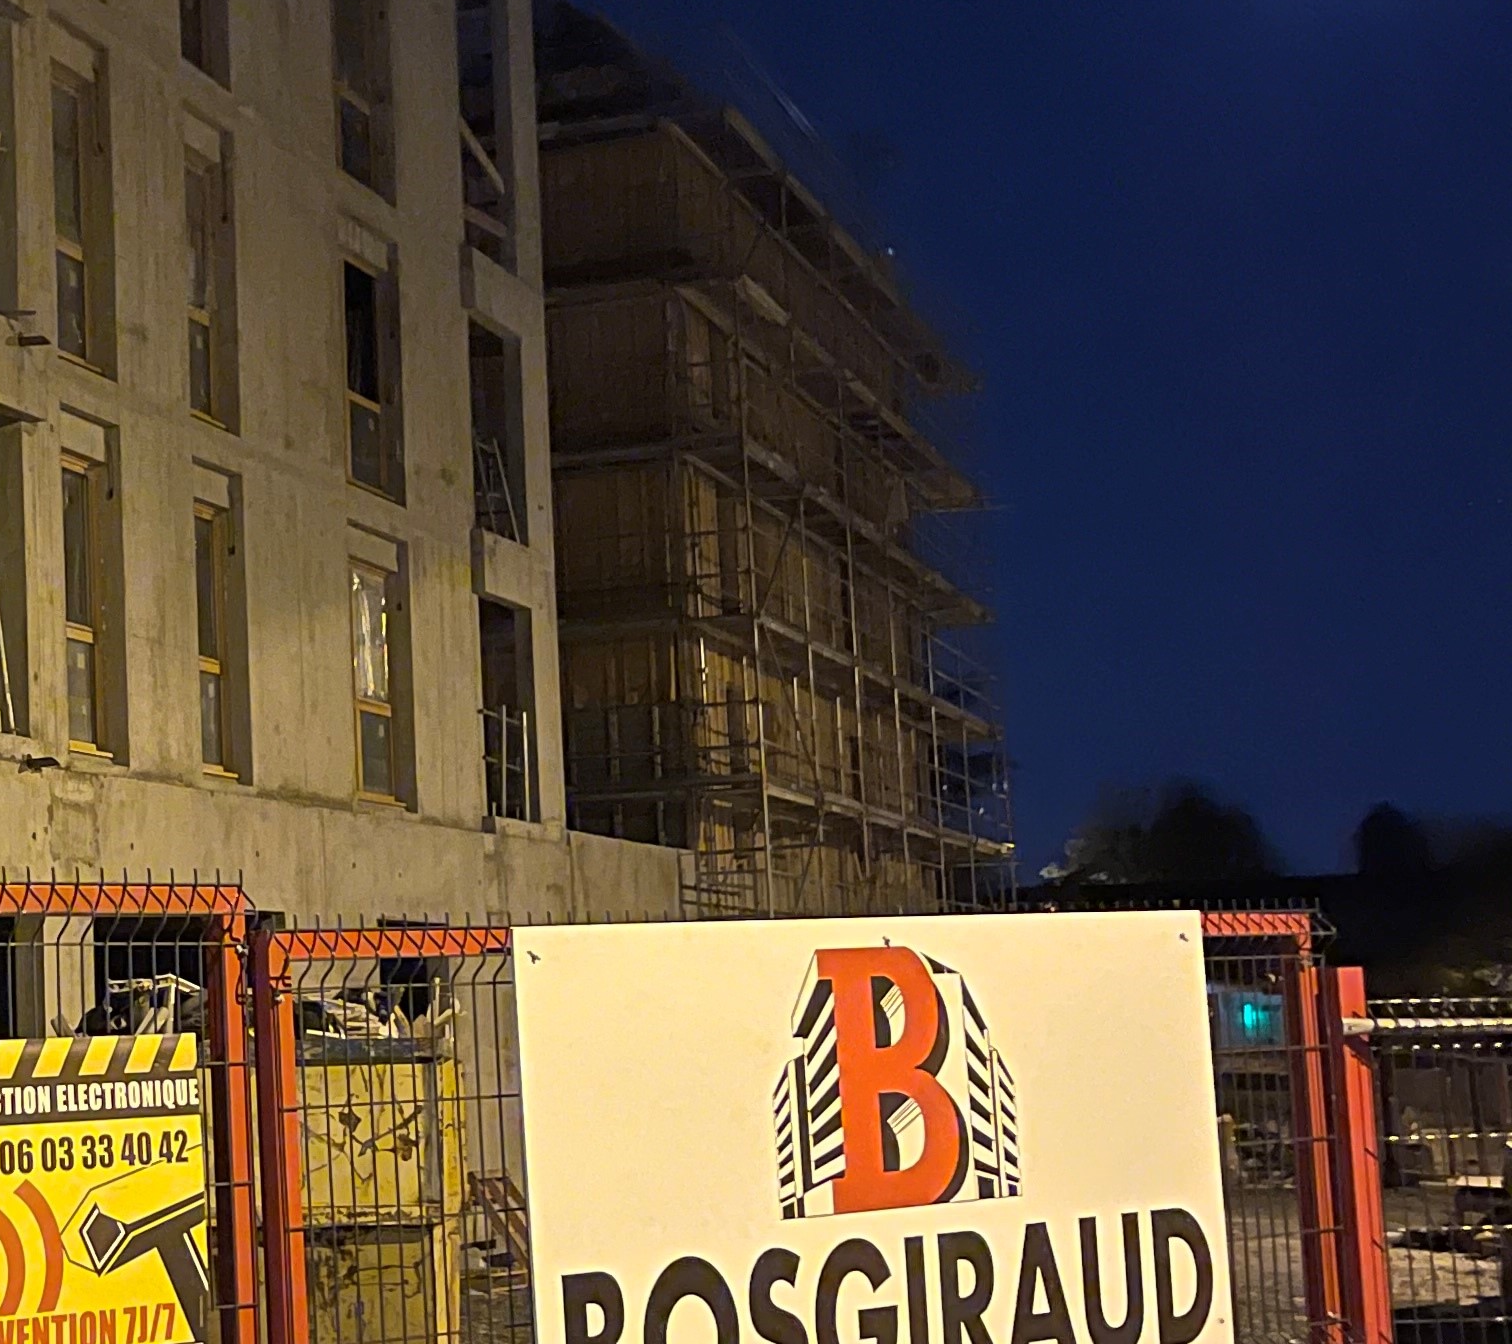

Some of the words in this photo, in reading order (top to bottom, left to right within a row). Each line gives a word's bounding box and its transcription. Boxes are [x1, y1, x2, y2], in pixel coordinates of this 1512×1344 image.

[56, 1078, 200, 1113] ELECTRONIQUE
[0, 1140, 34, 1175] 06
[41, 1139, 74, 1172] 03
[82, 1135, 114, 1169] 33
[120, 1133, 152, 1165] 40
[158, 1130, 189, 1163] 42
[122, 1302, 176, 1344] 7J/7
